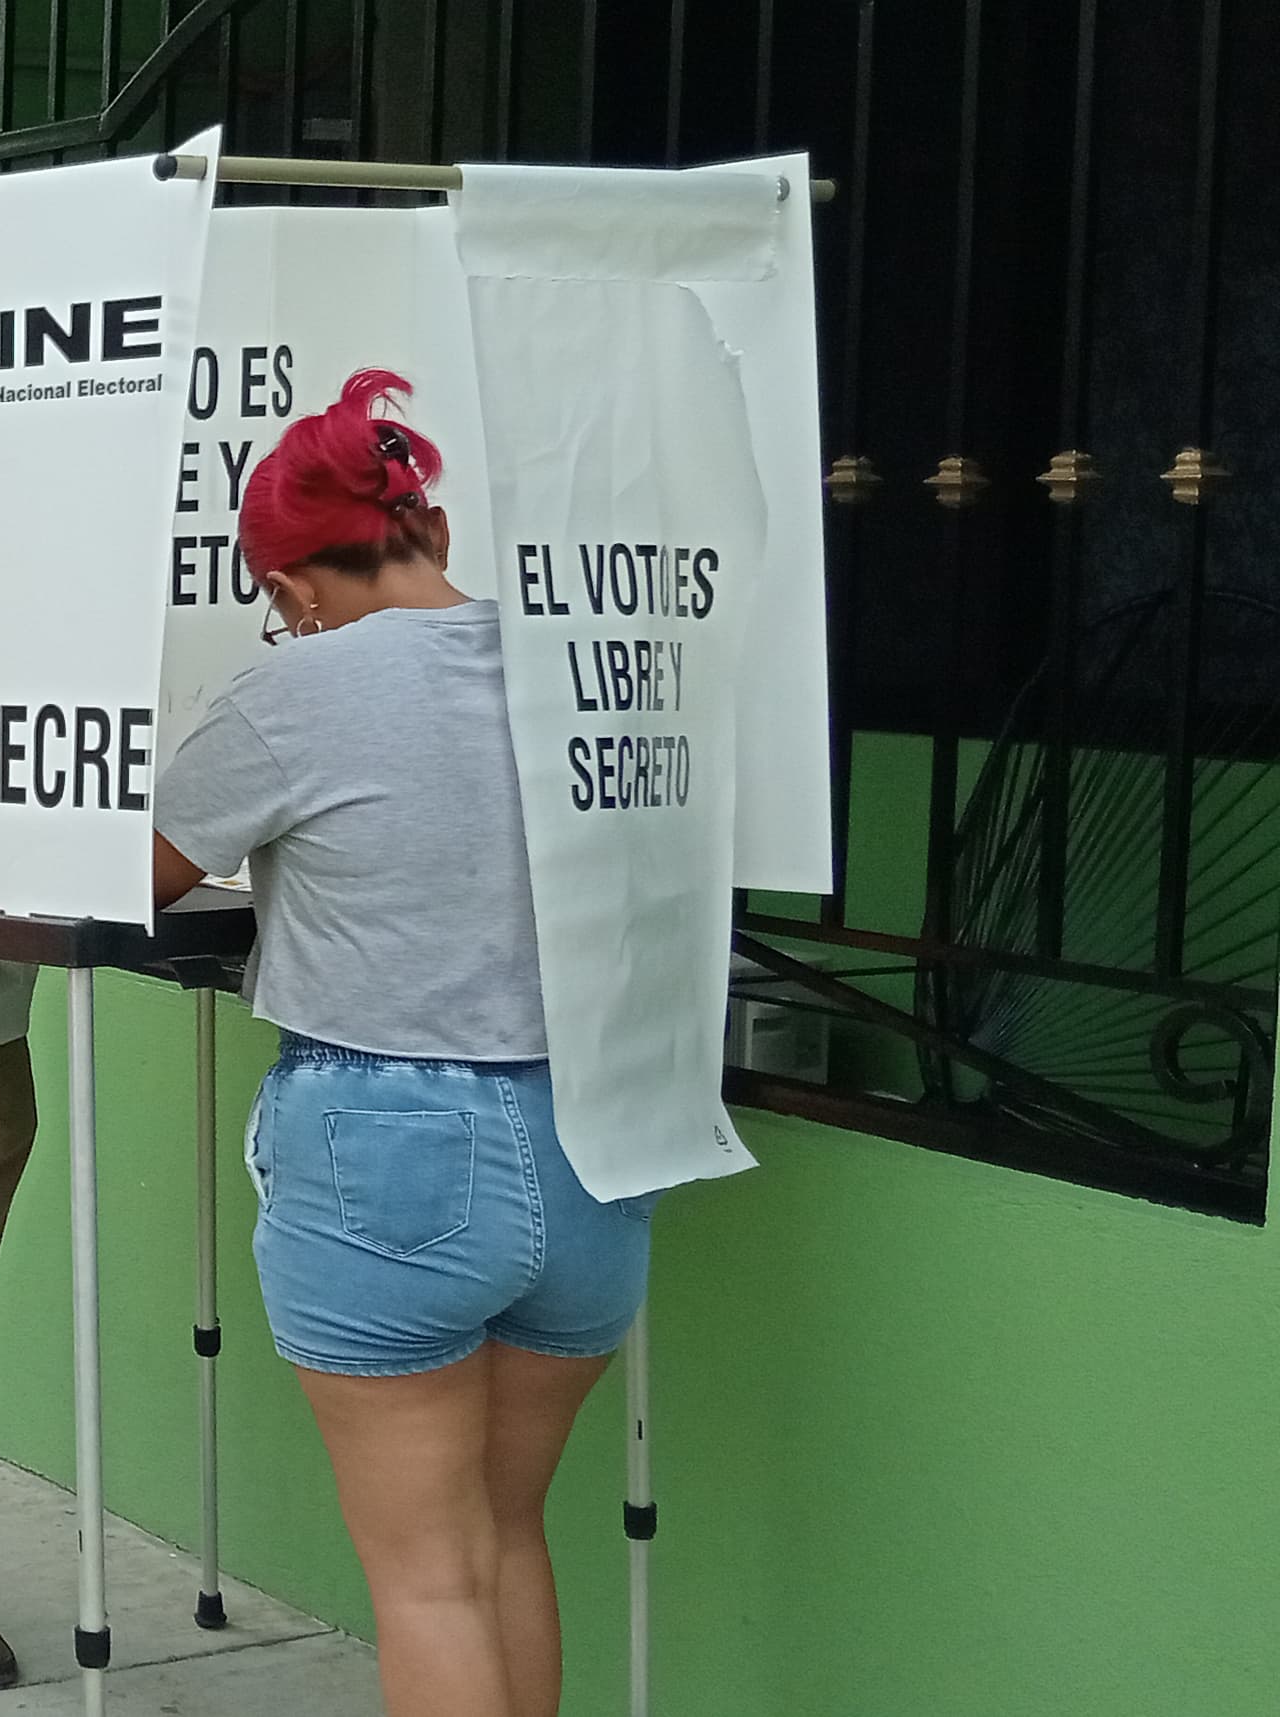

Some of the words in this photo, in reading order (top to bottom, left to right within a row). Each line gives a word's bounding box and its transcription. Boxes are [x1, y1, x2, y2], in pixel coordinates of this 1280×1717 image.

[77, 374, 162, 397] Electoral
[240, 345, 293, 417] ES
[218, 441, 253, 511] Y
[517, 544, 570, 616] EL
[579, 543, 671, 617] VOTO
[674, 547, 719, 619] ES
[567, 640, 664, 712] LIBRE
[670, 641, 682, 711] Y
[568, 735, 689, 812] SECRETO
